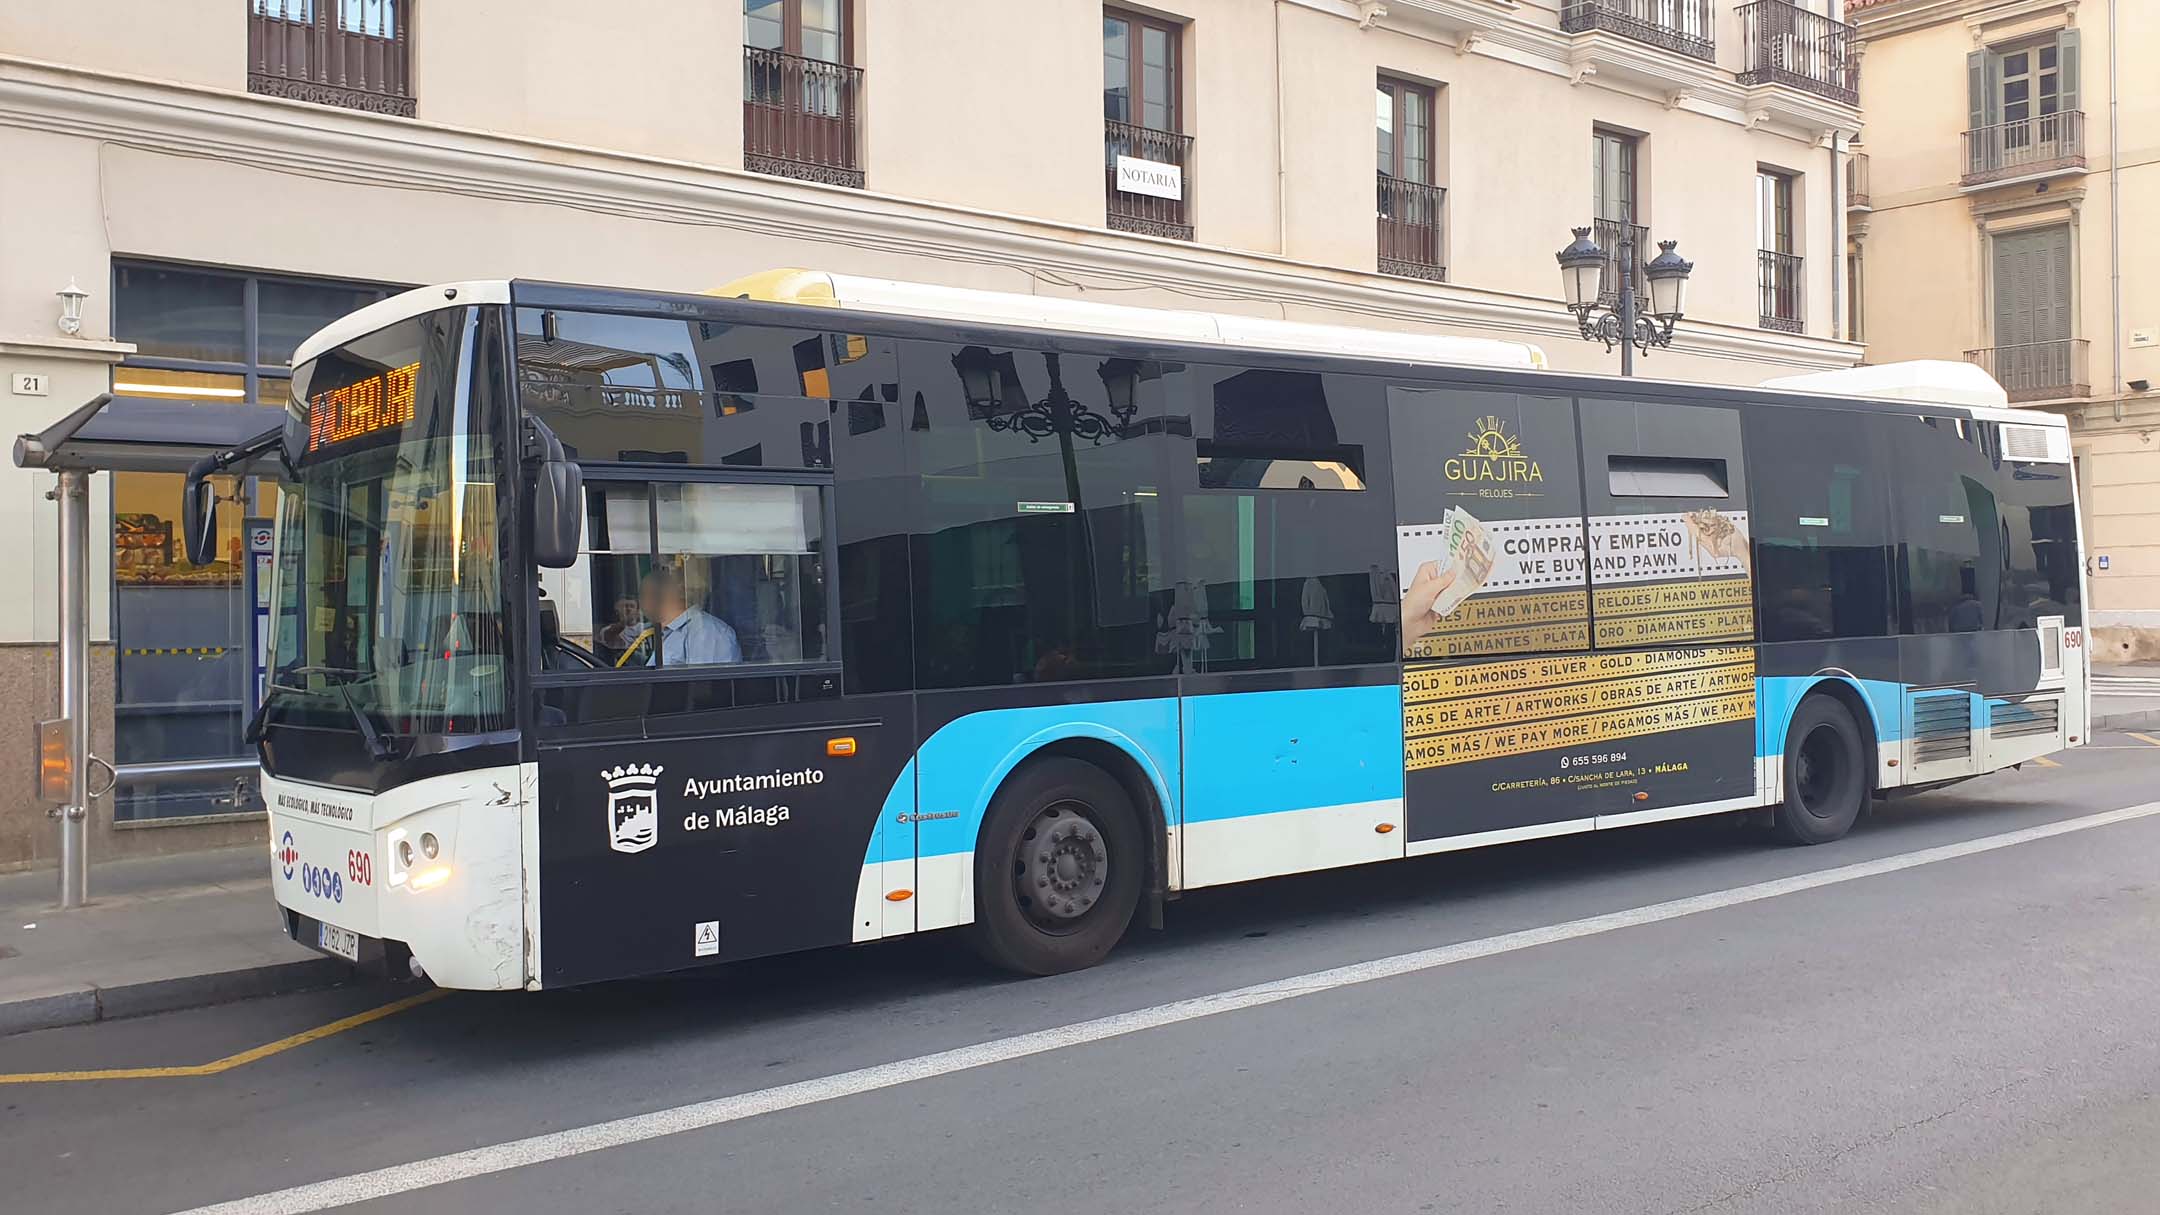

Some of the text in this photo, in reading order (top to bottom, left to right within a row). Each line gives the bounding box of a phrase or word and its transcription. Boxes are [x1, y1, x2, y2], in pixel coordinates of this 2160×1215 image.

[1122, 167, 1176, 189] NOTARIA
[23, 377, 38, 391] 21
[1445, 459, 1543, 482] GUAJIRA
[1479, 488, 1513, 498] RELOJES
[1504, 528, 1682, 555] COMPRA Y EMPEÑO
[1519, 553, 1677, 574] WE BUY AND PAWN
[1476, 605, 1515, 619] HAND
[1520, 599, 1585, 615] WATCHES
[1599, 594, 1651, 609] RELOJES
[1663, 590, 1697, 603] HAND
[1448, 635, 1530, 654] DIAMANTES
[1544, 630, 1586, 644] PLATA
[1600, 626, 1624, 638] ORO
[1637, 618, 1706, 635] DIAMANTES
[1718, 614, 1752, 627] PLATA
[2064, 631, 2082, 648] 690
[1403, 678, 1439, 692] GOLD
[1455, 668, 1528, 687] DIAMONDS
[1541, 661, 1587, 677] SILVER
[1600, 656, 1633, 670] GOLD
[1645, 649, 1706, 664] DIAMONDS
[1405, 713, 1434, 728] RAS
[1440, 710, 1458, 723] DE
[1464, 704, 1501, 720] ARTE
[1515, 693, 1588, 713] ARTWORKS
[1600, 686, 1642, 701] OBRAS
[1646, 683, 1662, 695] DE
[1666, 679, 1697, 692] ARTE
[1405, 745, 1445, 761] AMOS
[1451, 735, 1481, 754] MÁS
[1495, 735, 1516, 748] WE
[1521, 730, 1548, 744] PAY
[1553, 724, 1589, 739] MORE
[1601, 713, 1660, 731] PAGAMOS
[1665, 705, 1689, 722] MÁS
[1700, 705, 1718, 717] WE
[1722, 701, 1745, 714] PAY
[1572, 752, 1627, 767] 655 596 894
[1604, 771, 1615, 779] DE
[1637, 767, 1646, 776] 13
[683, 767, 824, 800] Ayuntamiento
[683, 804, 790, 831] de Málaga
[348, 849, 371, 886] 690
